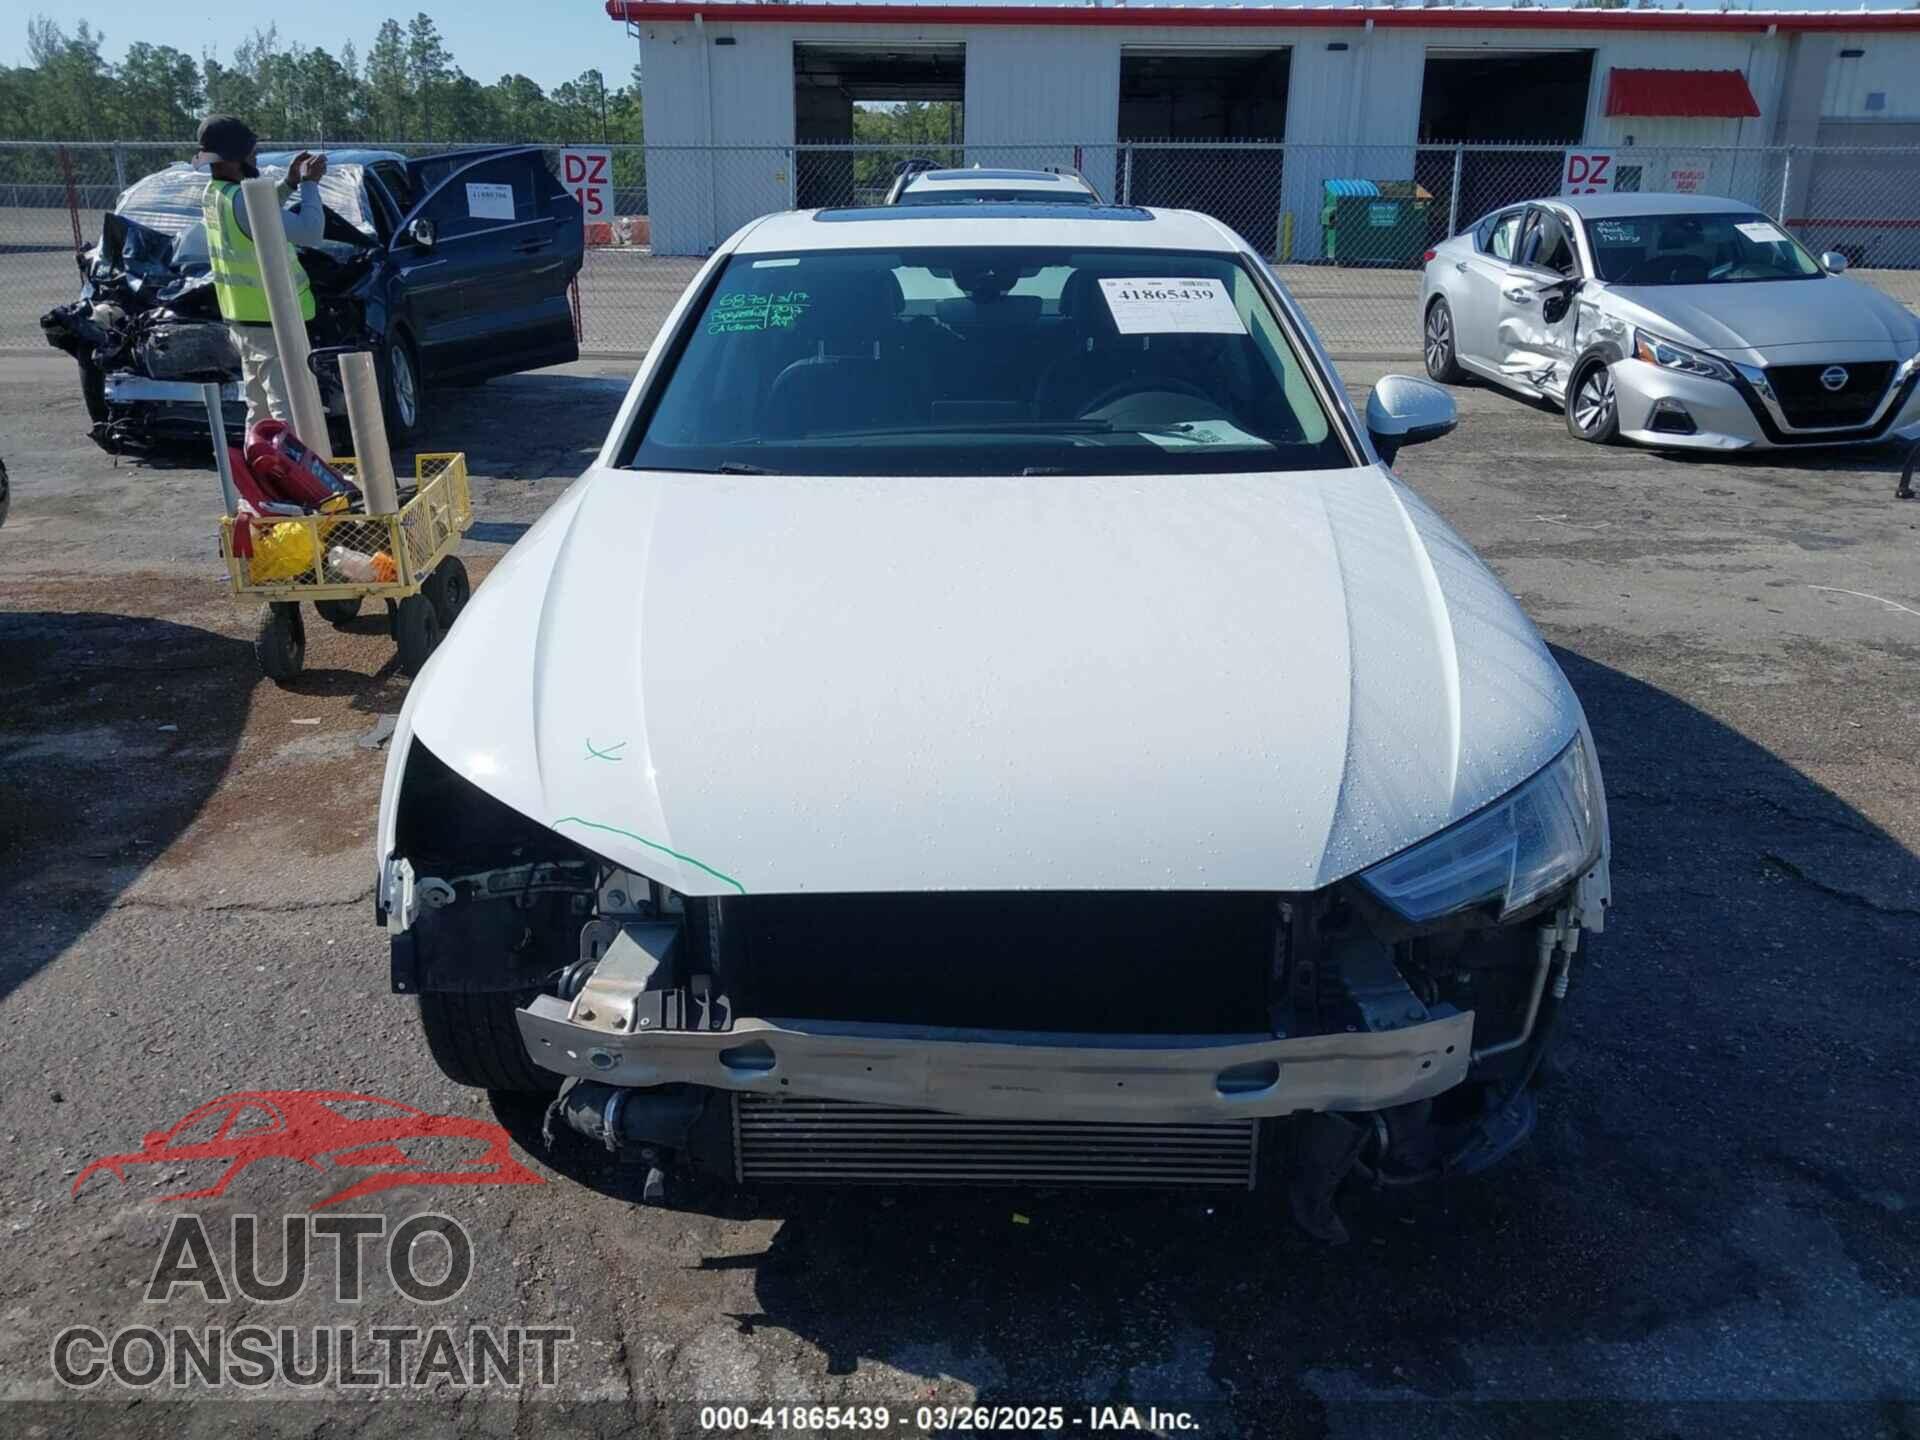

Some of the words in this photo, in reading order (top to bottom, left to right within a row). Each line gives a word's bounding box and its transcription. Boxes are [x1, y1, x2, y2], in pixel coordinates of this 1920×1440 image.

[565, 155, 608, 184] DZ
[1568, 155, 1611, 184] DZ
[1119, 289, 1215, 300] 41865439
